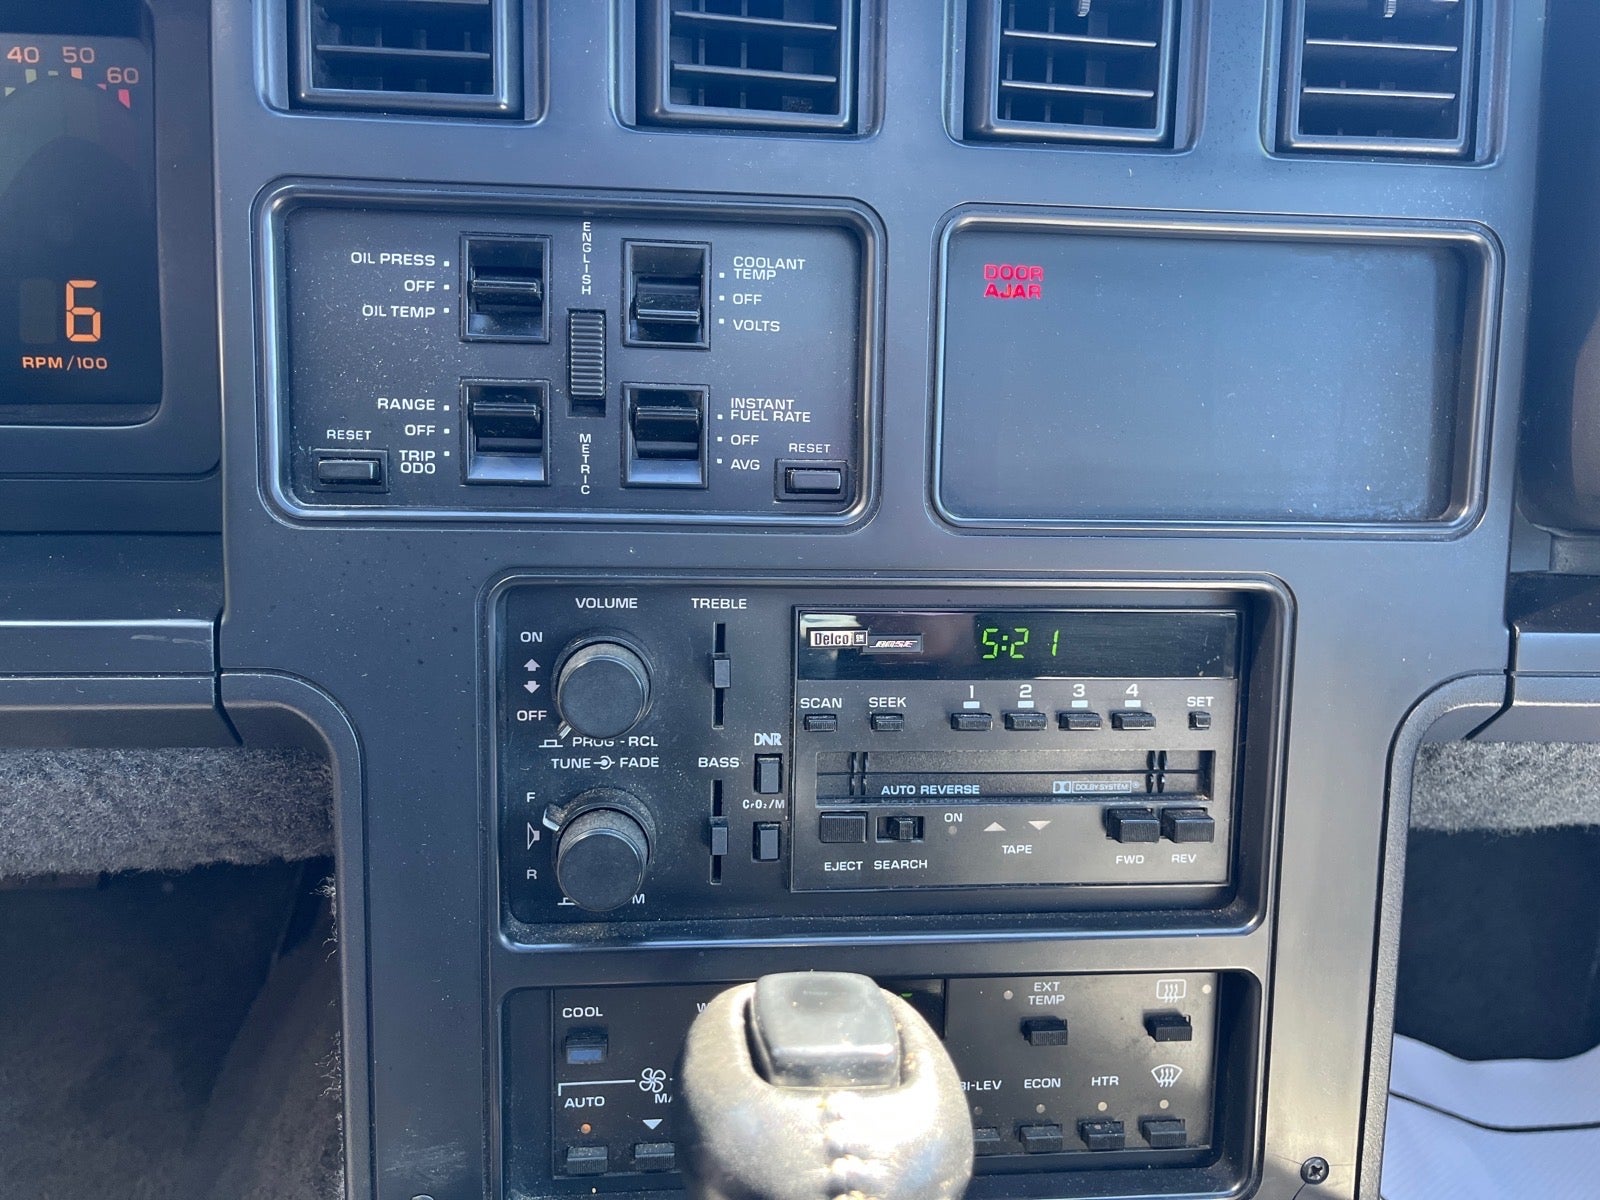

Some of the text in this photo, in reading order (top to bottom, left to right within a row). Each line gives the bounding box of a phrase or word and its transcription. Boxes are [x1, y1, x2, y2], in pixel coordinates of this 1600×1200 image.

[7, 46, 40, 64] 40
[62, 46, 95, 64] 50
[106, 67, 139, 84] 60
[350, 252, 436, 267] OIL PRESS
[581, 221, 592, 295] ENGLISH
[733, 256, 806, 270] COOLANT
[734, 268, 777, 281] TEMP
[984, 264, 1044, 281] DOOR
[404, 280, 436, 292] OFF
[984, 283, 1042, 300] AJAR
[732, 293, 762, 305] OFF
[65, 280, 101, 343] 6
[362, 304, 436, 318] OIL TEMP
[733, 319, 780, 332] VOLTS
[377, 398, 436, 411] RANGE
[731, 398, 794, 410] INSTANT
[730, 409, 811, 423] FUEL RATE
[326, 429, 372, 441] RESET
[404, 424, 436, 436] OFF
[731, 434, 759, 446] OFF
[789, 443, 831, 453] RESET
[399, 450, 436, 462] TRIP
[400, 463, 436, 475] ODO
[579, 434, 592, 495] METRIC
[730, 459, 760, 471] AVG
[575, 597, 638, 609] VOLUME
[691, 598, 747, 610] TREBLE
[520, 631, 543, 643] ON
[815, 632, 849, 646] Delco
[869, 640, 918, 648] BOSE
[969, 685, 975, 699] 1
[1019, 684, 1032, 698] 2
[1072, 684, 1086, 697] 3
[1125, 683, 1139, 697] 4
[800, 697, 842, 709] SCAN
[868, 697, 907, 708] SEEK
[1186, 696, 1214, 707] SET
[516, 710, 547, 722] OFF
[628, 736, 659, 747] RCL
[754, 732, 782, 746] DNR
[551, 758, 591, 769] TUNE
[620, 757, 660, 768] FADE
[698, 757, 740, 769] BASS
[881, 784, 980, 795] AUTO REVERSE
[1075, 783, 1129, 791] DOLBY SYSTEM
[526, 792, 536, 802] F
[944, 812, 963, 823] ON
[1002, 845, 1032, 855] TAPE
[873, 859, 928, 870] SEARCH
[1116, 855, 1144, 865] FWD
[1171, 854, 1197, 864] REV
[824, 860, 863, 872] EJECT
[526, 869, 537, 880] R
[1033, 982, 1060, 992] EXT
[1028, 994, 1065, 1006] TEMP
[562, 1006, 603, 1018] COOL
[1024, 1078, 1061, 1089] ECON
[1091, 1076, 1119, 1087] HTR
[564, 1096, 605, 1108] AUTO
